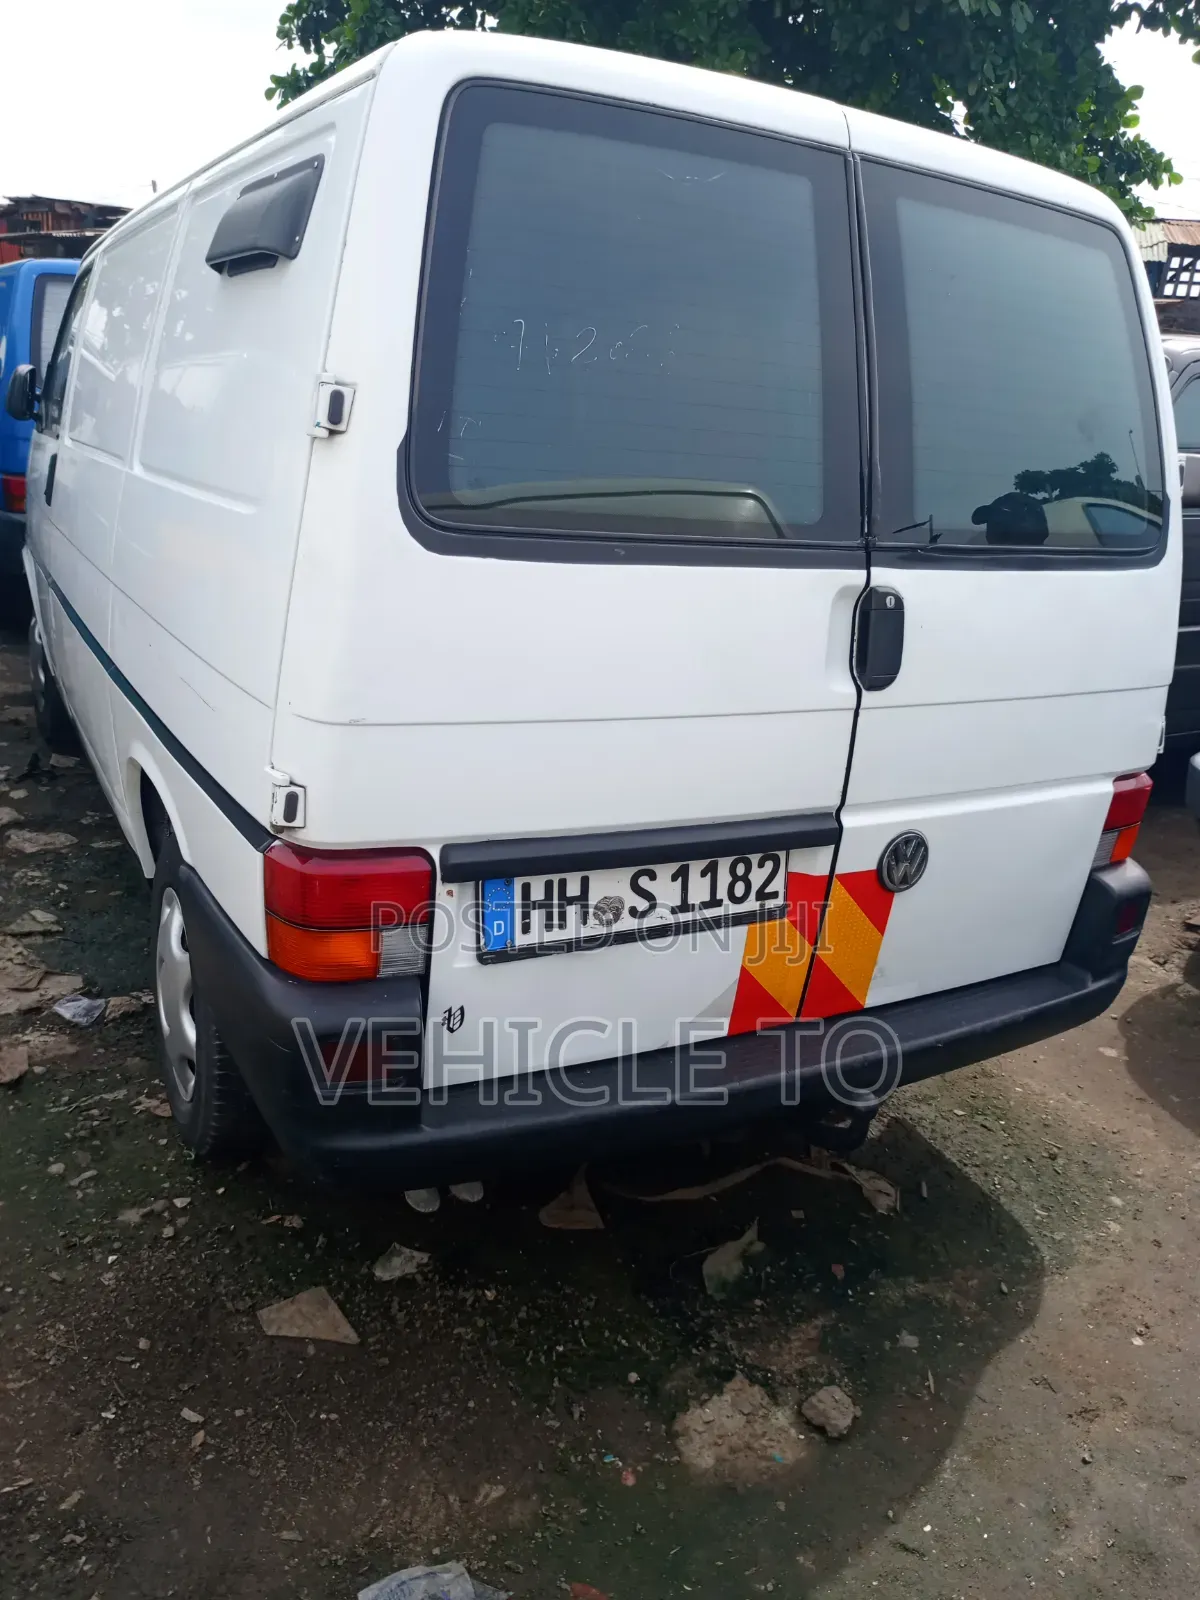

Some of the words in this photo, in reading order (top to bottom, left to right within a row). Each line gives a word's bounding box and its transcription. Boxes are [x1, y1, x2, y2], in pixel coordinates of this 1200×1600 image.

[880, 831, 928, 891] VW
[521, 875, 590, 935] HH
[628, 868, 658, 919] S
[670, 852, 782, 914] 1182
[493, 920, 505, 936] D
